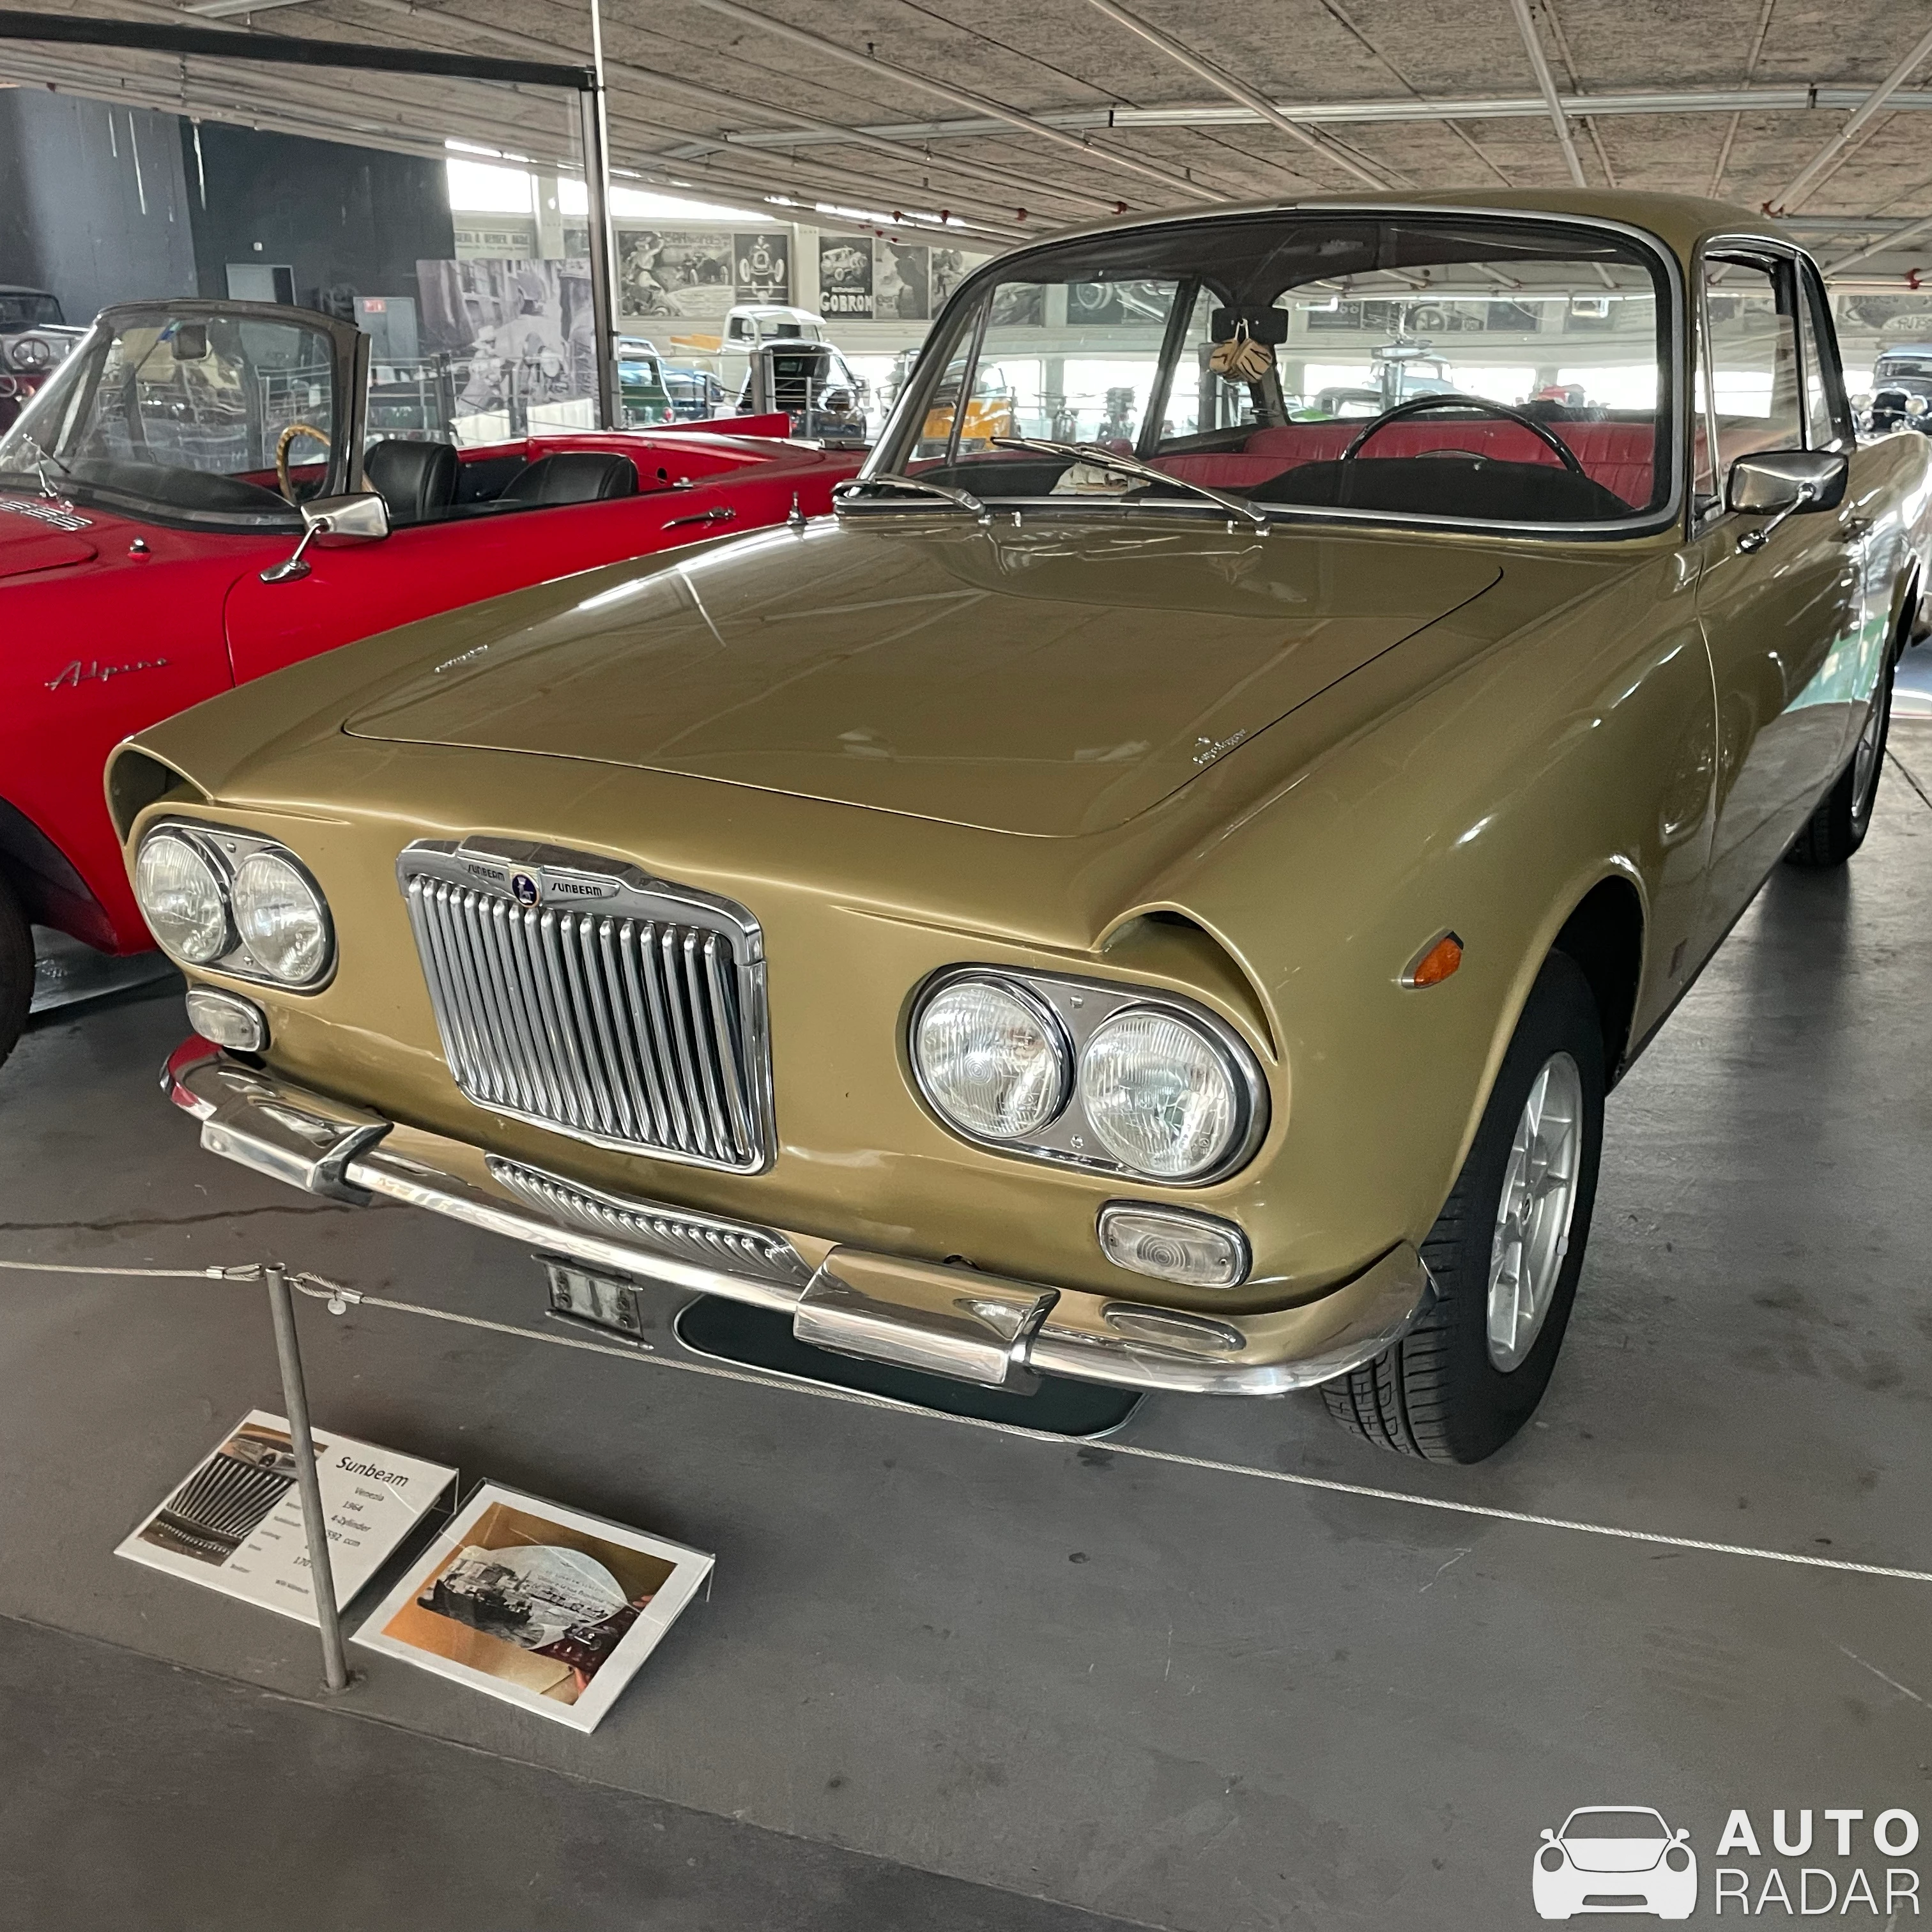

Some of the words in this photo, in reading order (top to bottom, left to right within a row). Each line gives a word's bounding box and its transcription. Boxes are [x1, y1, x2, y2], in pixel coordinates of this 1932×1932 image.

[820, 291, 873, 312] GOBRON
[467, 864, 505, 882] SUNBEAM
[551, 882, 602, 896] SUNBEAM
[335, 1456, 410, 1487] Sunbeam
